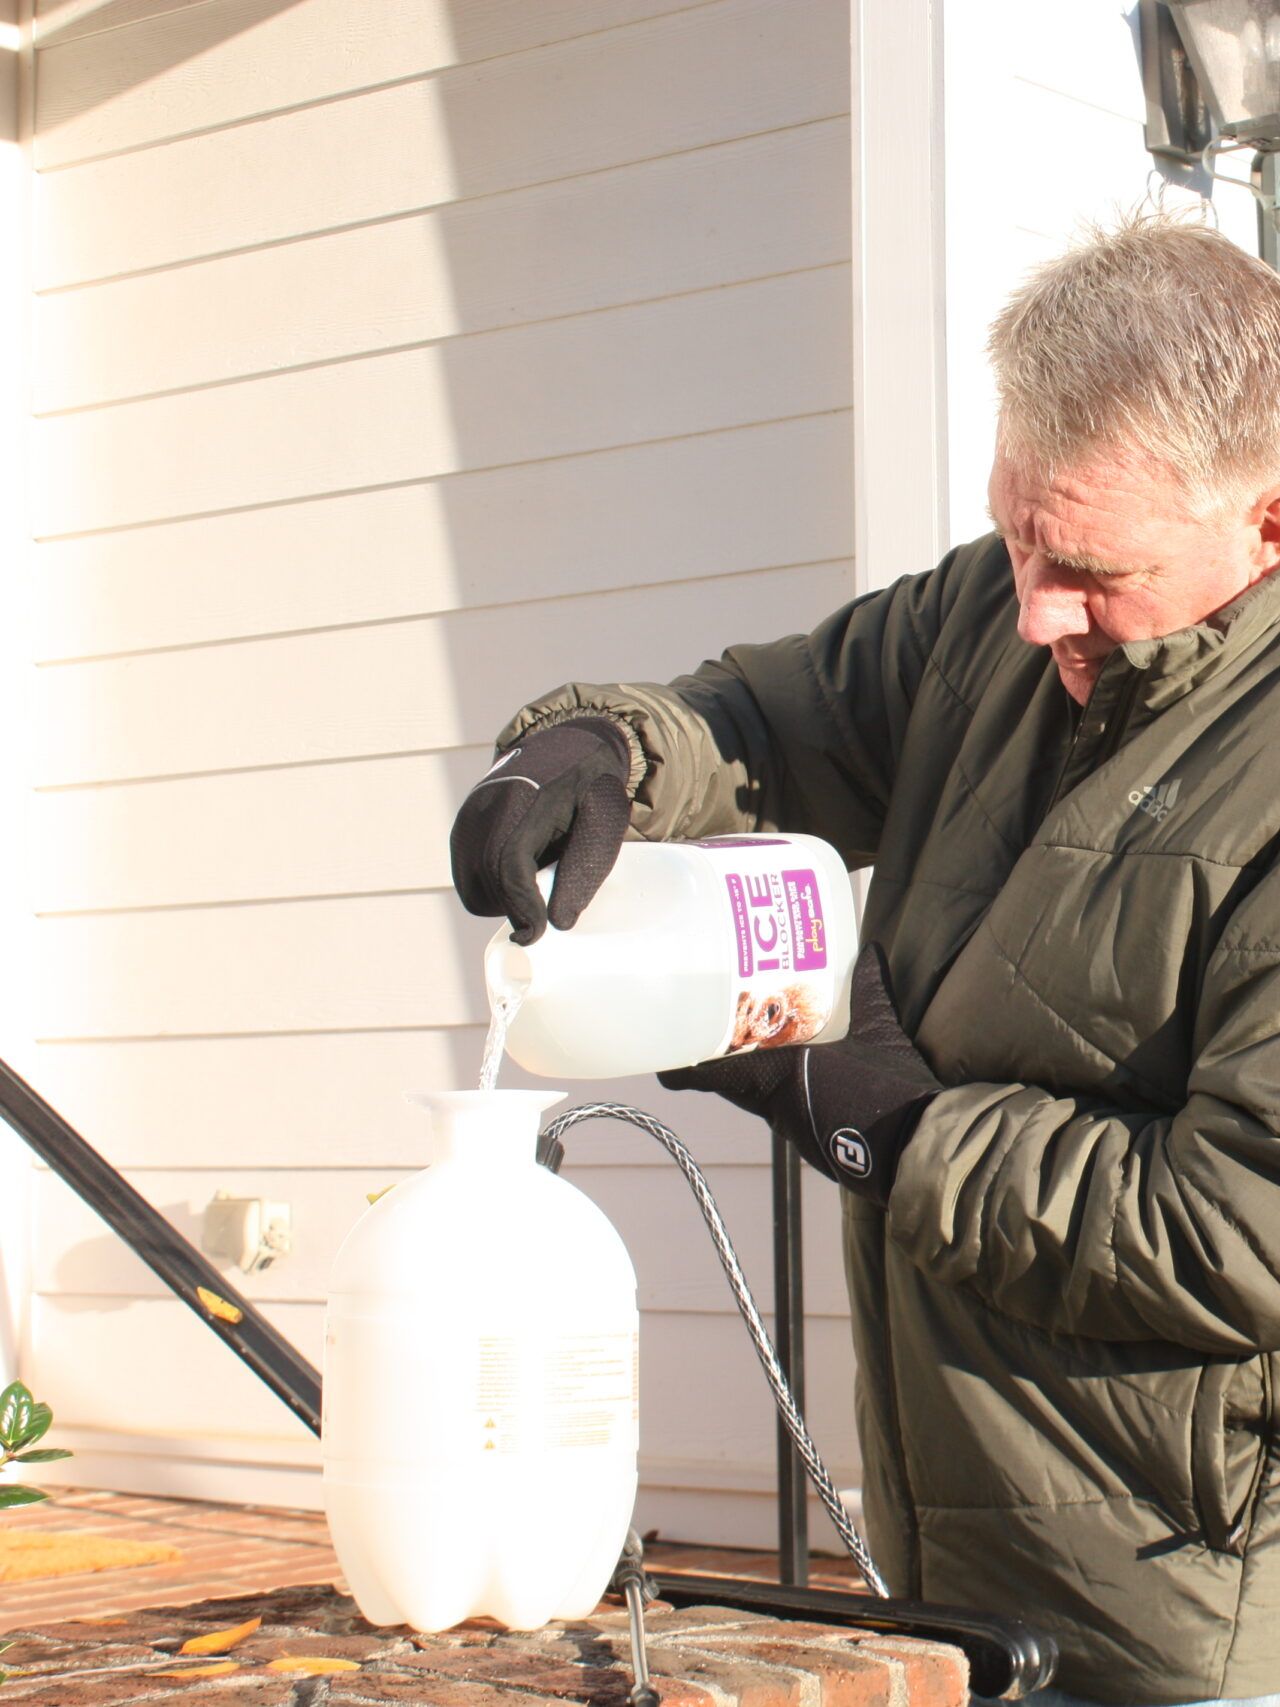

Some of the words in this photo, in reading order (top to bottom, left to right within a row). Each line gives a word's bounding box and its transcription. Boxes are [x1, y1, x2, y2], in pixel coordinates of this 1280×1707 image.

[737, 901, 743, 913] TO
[745, 873, 780, 971] ICE
[770, 873, 790, 970] BLOCKER
